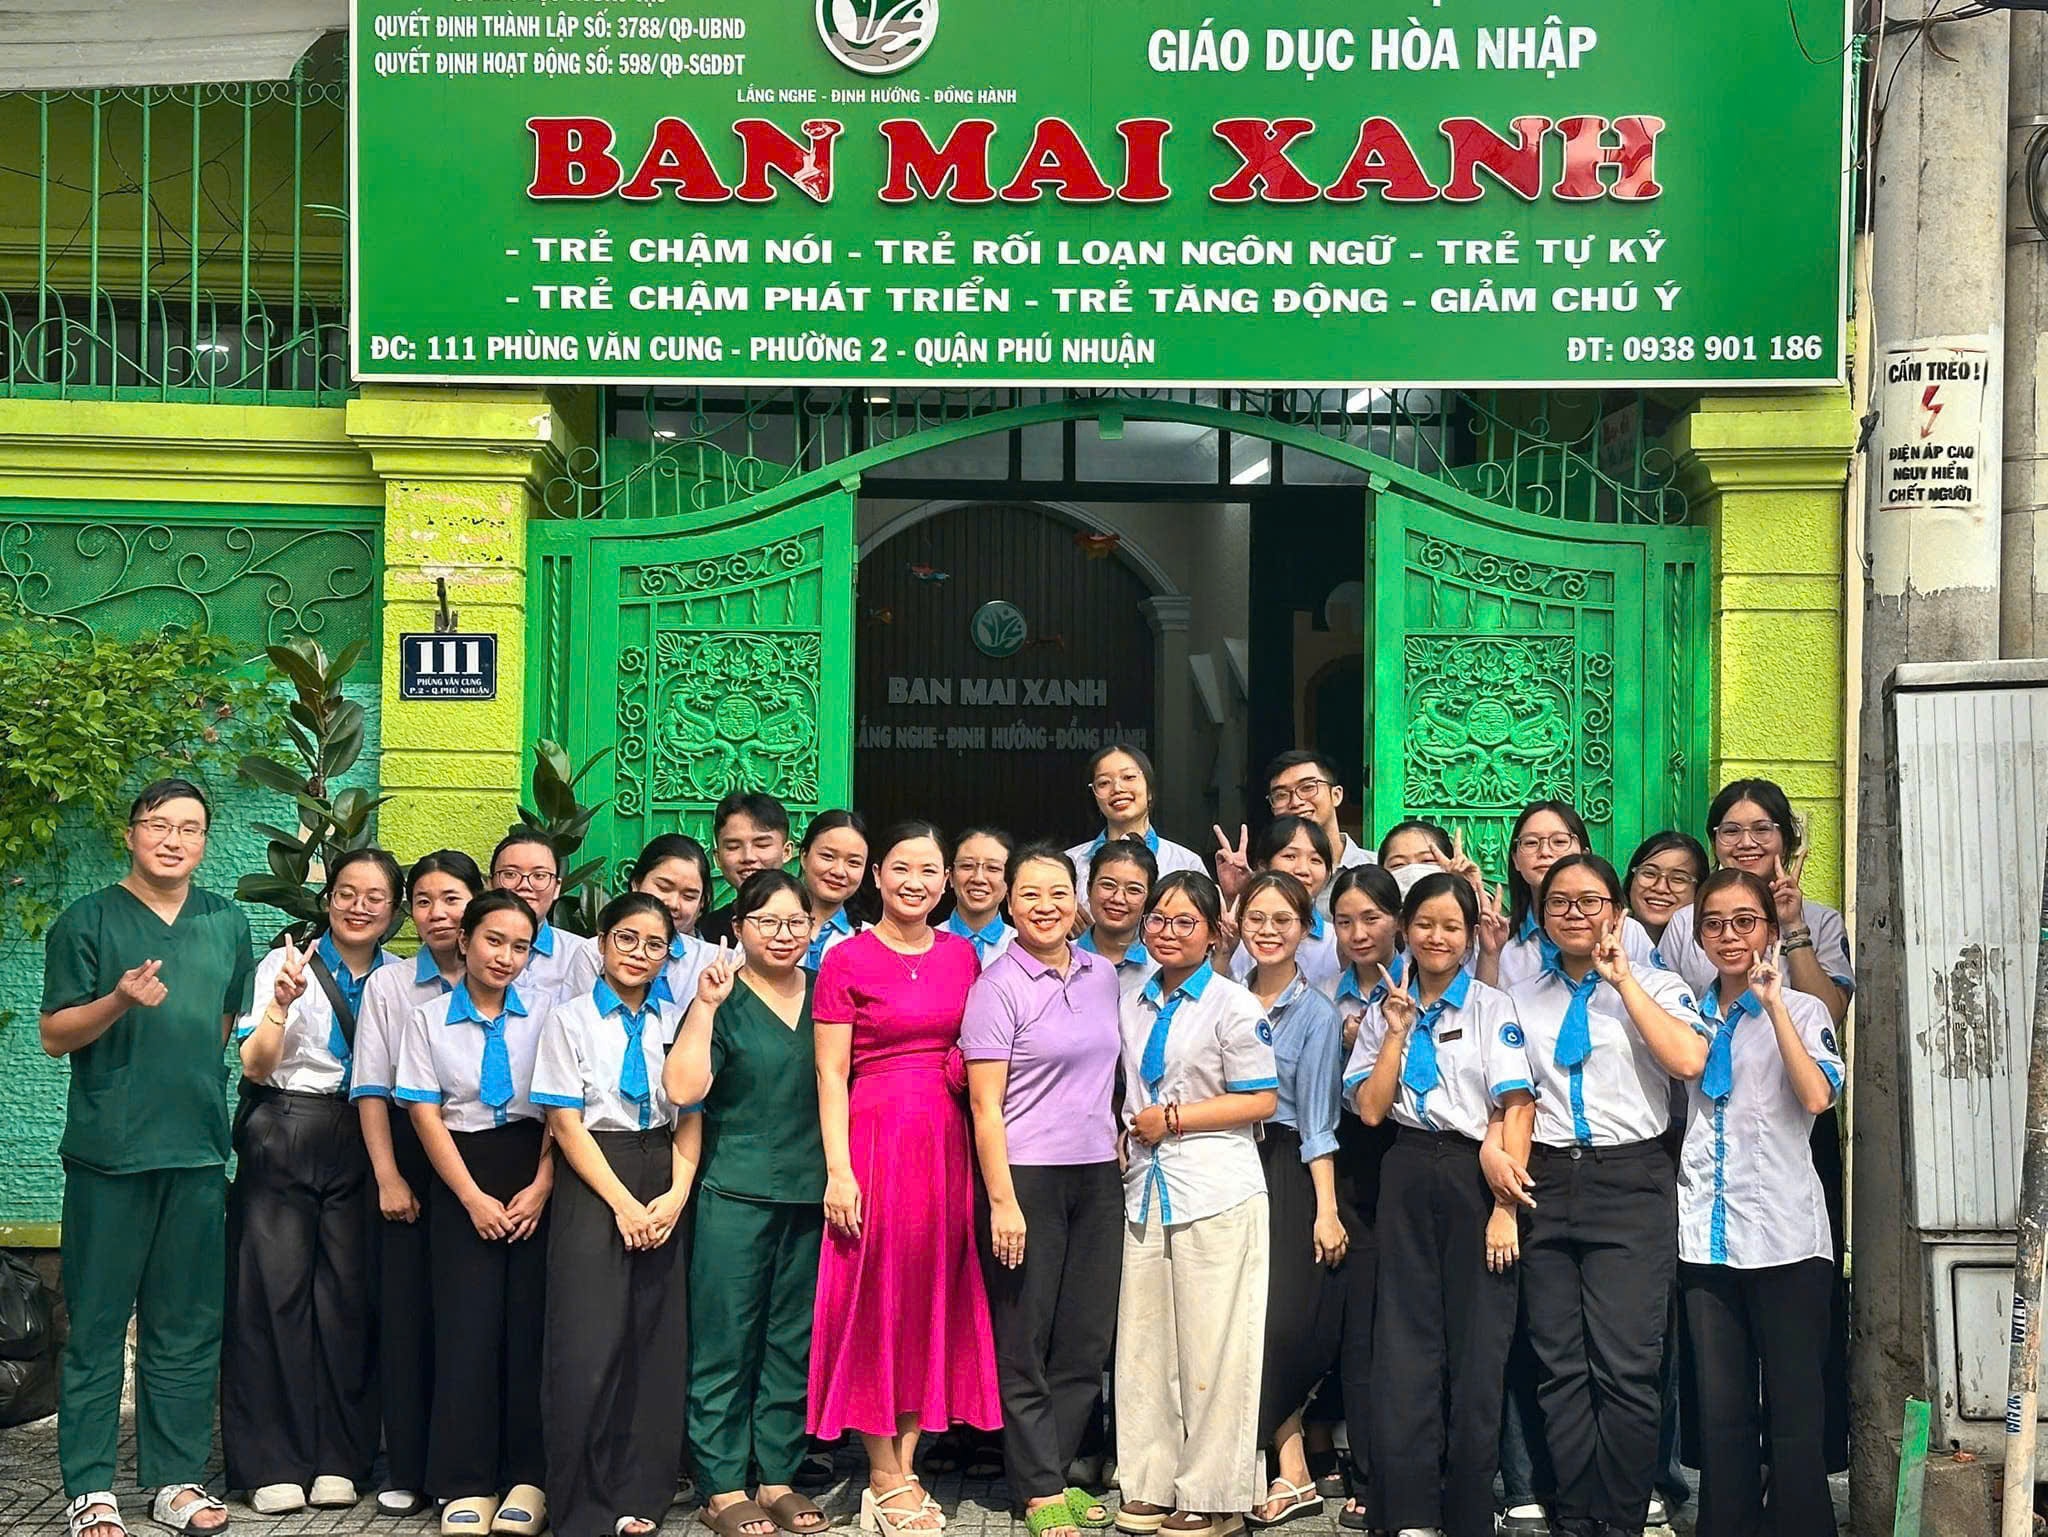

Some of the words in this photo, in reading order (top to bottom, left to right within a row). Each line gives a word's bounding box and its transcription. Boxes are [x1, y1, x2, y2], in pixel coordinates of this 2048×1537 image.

[374, 8, 430, 40] QUYẾT
[436, 15, 477, 42] ĐỊNH
[482, 10, 540, 38] THÀNH
[546, 11, 579, 43] LẬP
[584, 8, 611, 38] SỐ:
[617, 17, 746, 43] 3788/QĐ-UBND
[374, 45, 430, 78] QUYẾT
[436, 52, 477, 79] ĐỊNH
[483, 52, 528, 79] HOẠT
[534, 47, 581, 79] ĐỘNG
[585, 45, 613, 75] SỐ:
[619, 53, 746, 79] 598/QĐ-SGDĐT
[1148, 17, 1250, 71] GIÁO
[1265, 28, 1355, 81] DỤC
[1371, 16, 1460, 71] HÒA
[1476, 15, 1598, 79] NHẬP
[737, 83, 774, 103] LẮNG
[779, 88, 816, 104] NGHE
[831, 88, 865, 106] ĐỊNH
[870, 86, 920, 104] HƯỚNG
[934, 85, 973, 104] ĐỒNG
[978, 85, 1017, 104] HÀNH
[526, 117, 843, 203] BAN
[878, 117, 1173, 202] MAI
[1209, 116, 1666, 203] XANH
[533, 228, 613, 263] TRẺ
[629, 232, 748, 268] CHẬM
[765, 233, 832, 264] NÓI
[875, 231, 955, 265] TRẺ
[973, 230, 1041, 265] RỐI
[1058, 240, 1165, 271] LOẠN
[1181, 234, 1293, 266] NGÔN
[1309, 234, 1397, 266] NGỮ
[1437, 230, 1519, 265] TRẺ
[1535, 234, 1595, 270] TỰ
[1609, 228, 1667, 263] KỶ
[533, 276, 613, 310] TRẺ
[629, 280, 748, 316] CHẬM
[764, 281, 871, 312] PHÁT
[885, 276, 1010, 312] TRIỂN
[1052, 279, 1132, 313] TRẺ
[1148, 283, 1259, 313] TĂNG
[1272, 281, 1388, 319] ĐỘNG
[1431, 278, 1536, 313] GIẢM
[1552, 280, 1637, 312] CHÚ
[1653, 279, 1682, 312] Ý
[370, 335, 416, 361] ĐC:
[427, 336, 476, 361] 111
[487, 329, 578, 361] PHÙNG
[586, 331, 640, 361] VĂN
[649, 336, 723, 362] CUNG
[750, 331, 862, 362] PHƯỜNG
[870, 337, 887, 362] 2
[914, 331, 988, 369] QUẬN
[997, 331, 1052, 363] PHÚ
[1062, 332, 1155, 369] NHUẬN
[1566, 337, 1614, 363] ĐT:
[1623, 336, 1695, 362] 0938
[1705, 336, 1757, 361] 901
[1770, 336, 1823, 361] 186
[1888, 357, 1922, 384] CẤM
[1889, 444, 1920, 463] ĐIỆN
[1947, 445, 1974, 459] CAO
[1893, 466, 1927, 481] NGUY
[1931, 461, 1969, 481] HIỂM
[1889, 483, 1925, 502] CHẾT
[1928, 484, 1972, 502] NGƯỜI
[415, 641, 483, 675] 111
[409, 687, 425, 695] P.2
[461, 678, 482, 686] CUNG
[888, 676, 951, 705] BAN
[960, 678, 1017, 706] MAI
[1022, 679, 1107, 707] XANH
[855, 717, 891, 749] ẮNG
